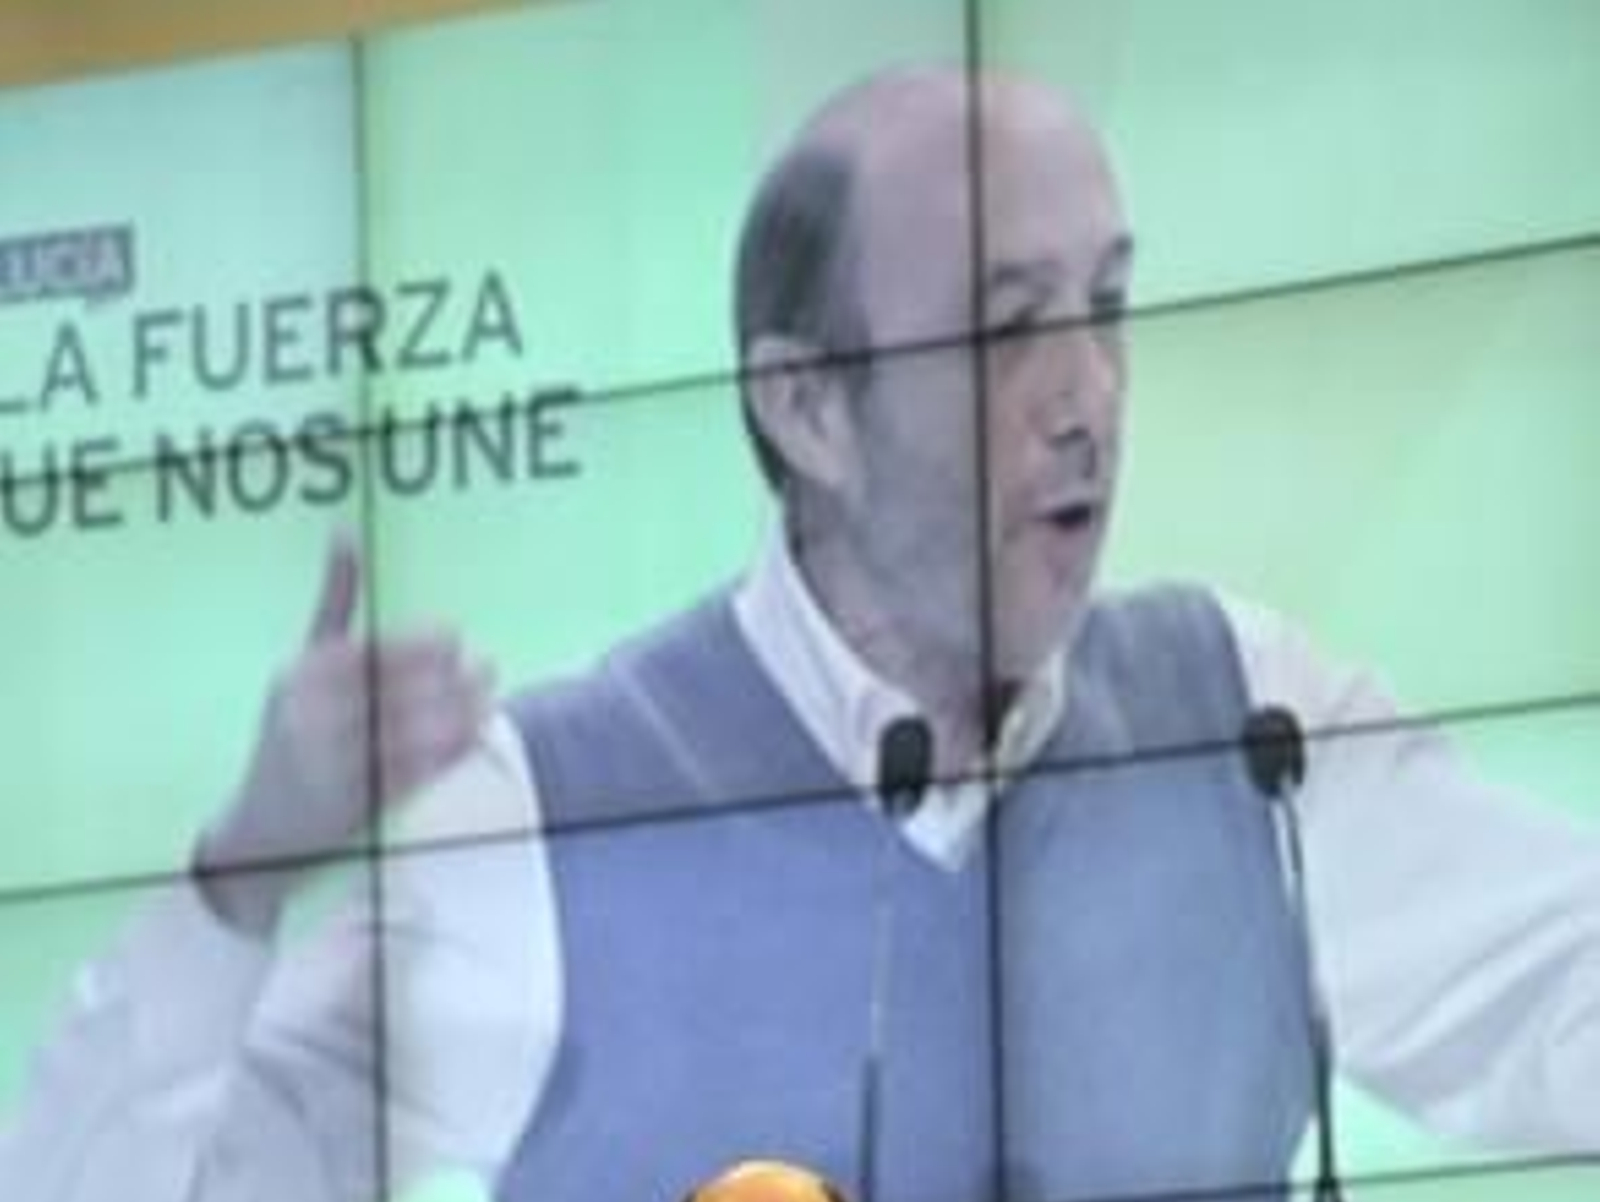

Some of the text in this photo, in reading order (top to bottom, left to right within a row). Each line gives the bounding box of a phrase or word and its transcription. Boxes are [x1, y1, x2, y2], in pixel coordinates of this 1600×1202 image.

[132, 270, 523, 400] FUERZA
[156, 412, 352, 523] NOS
[380, 384, 582, 496] UNE
